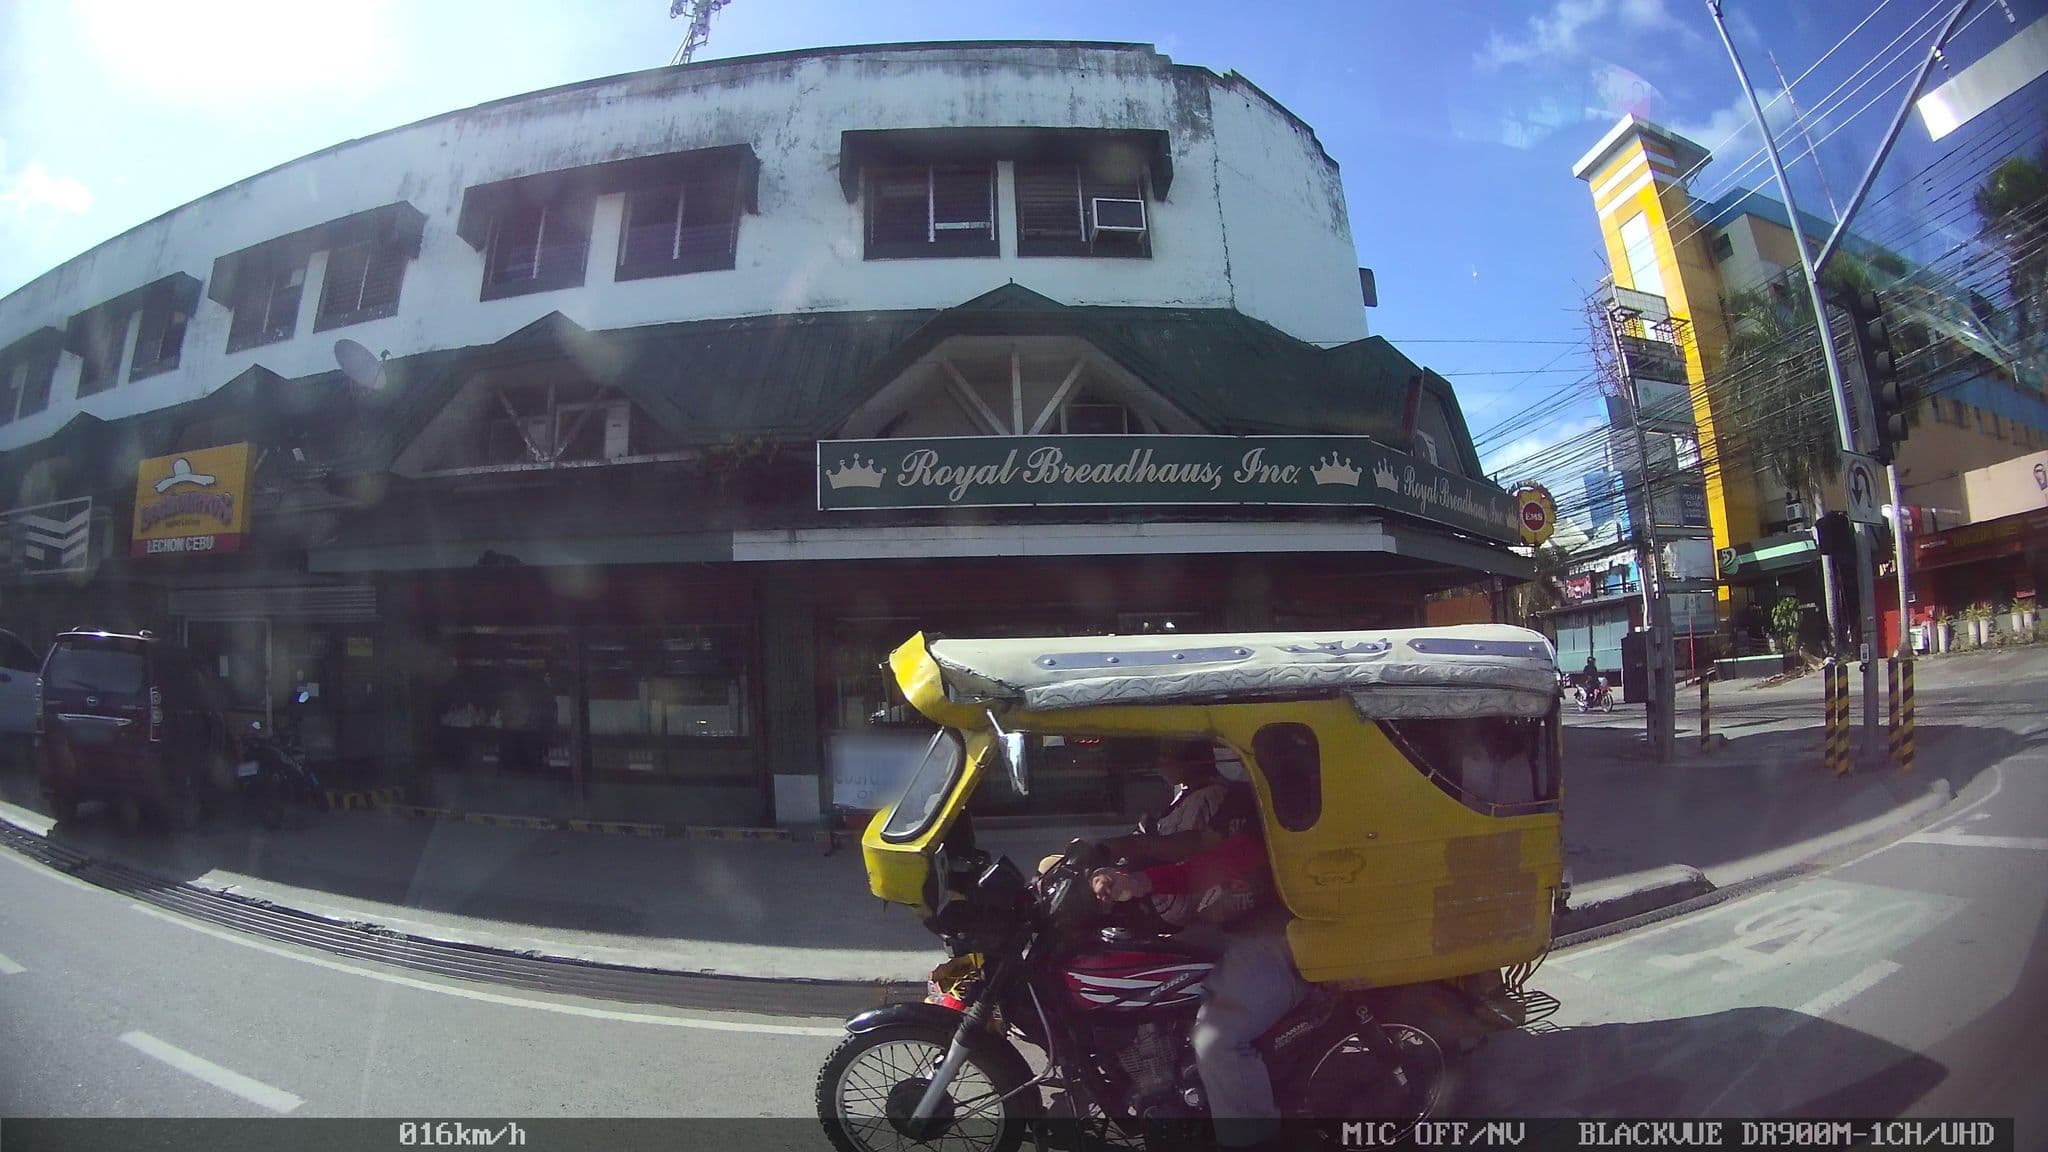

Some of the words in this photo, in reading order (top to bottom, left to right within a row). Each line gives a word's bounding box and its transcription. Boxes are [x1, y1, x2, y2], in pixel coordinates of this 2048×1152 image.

[897, 449, 1020, 502] Royal
[1022, 446, 1222, 491] Breadhaus,
[1233, 448, 1299, 484] Inc.
[1403, 465, 1438, 514] Royal
[147, 537, 185, 553] LECHON
[185, 535, 215, 551] CEBU
